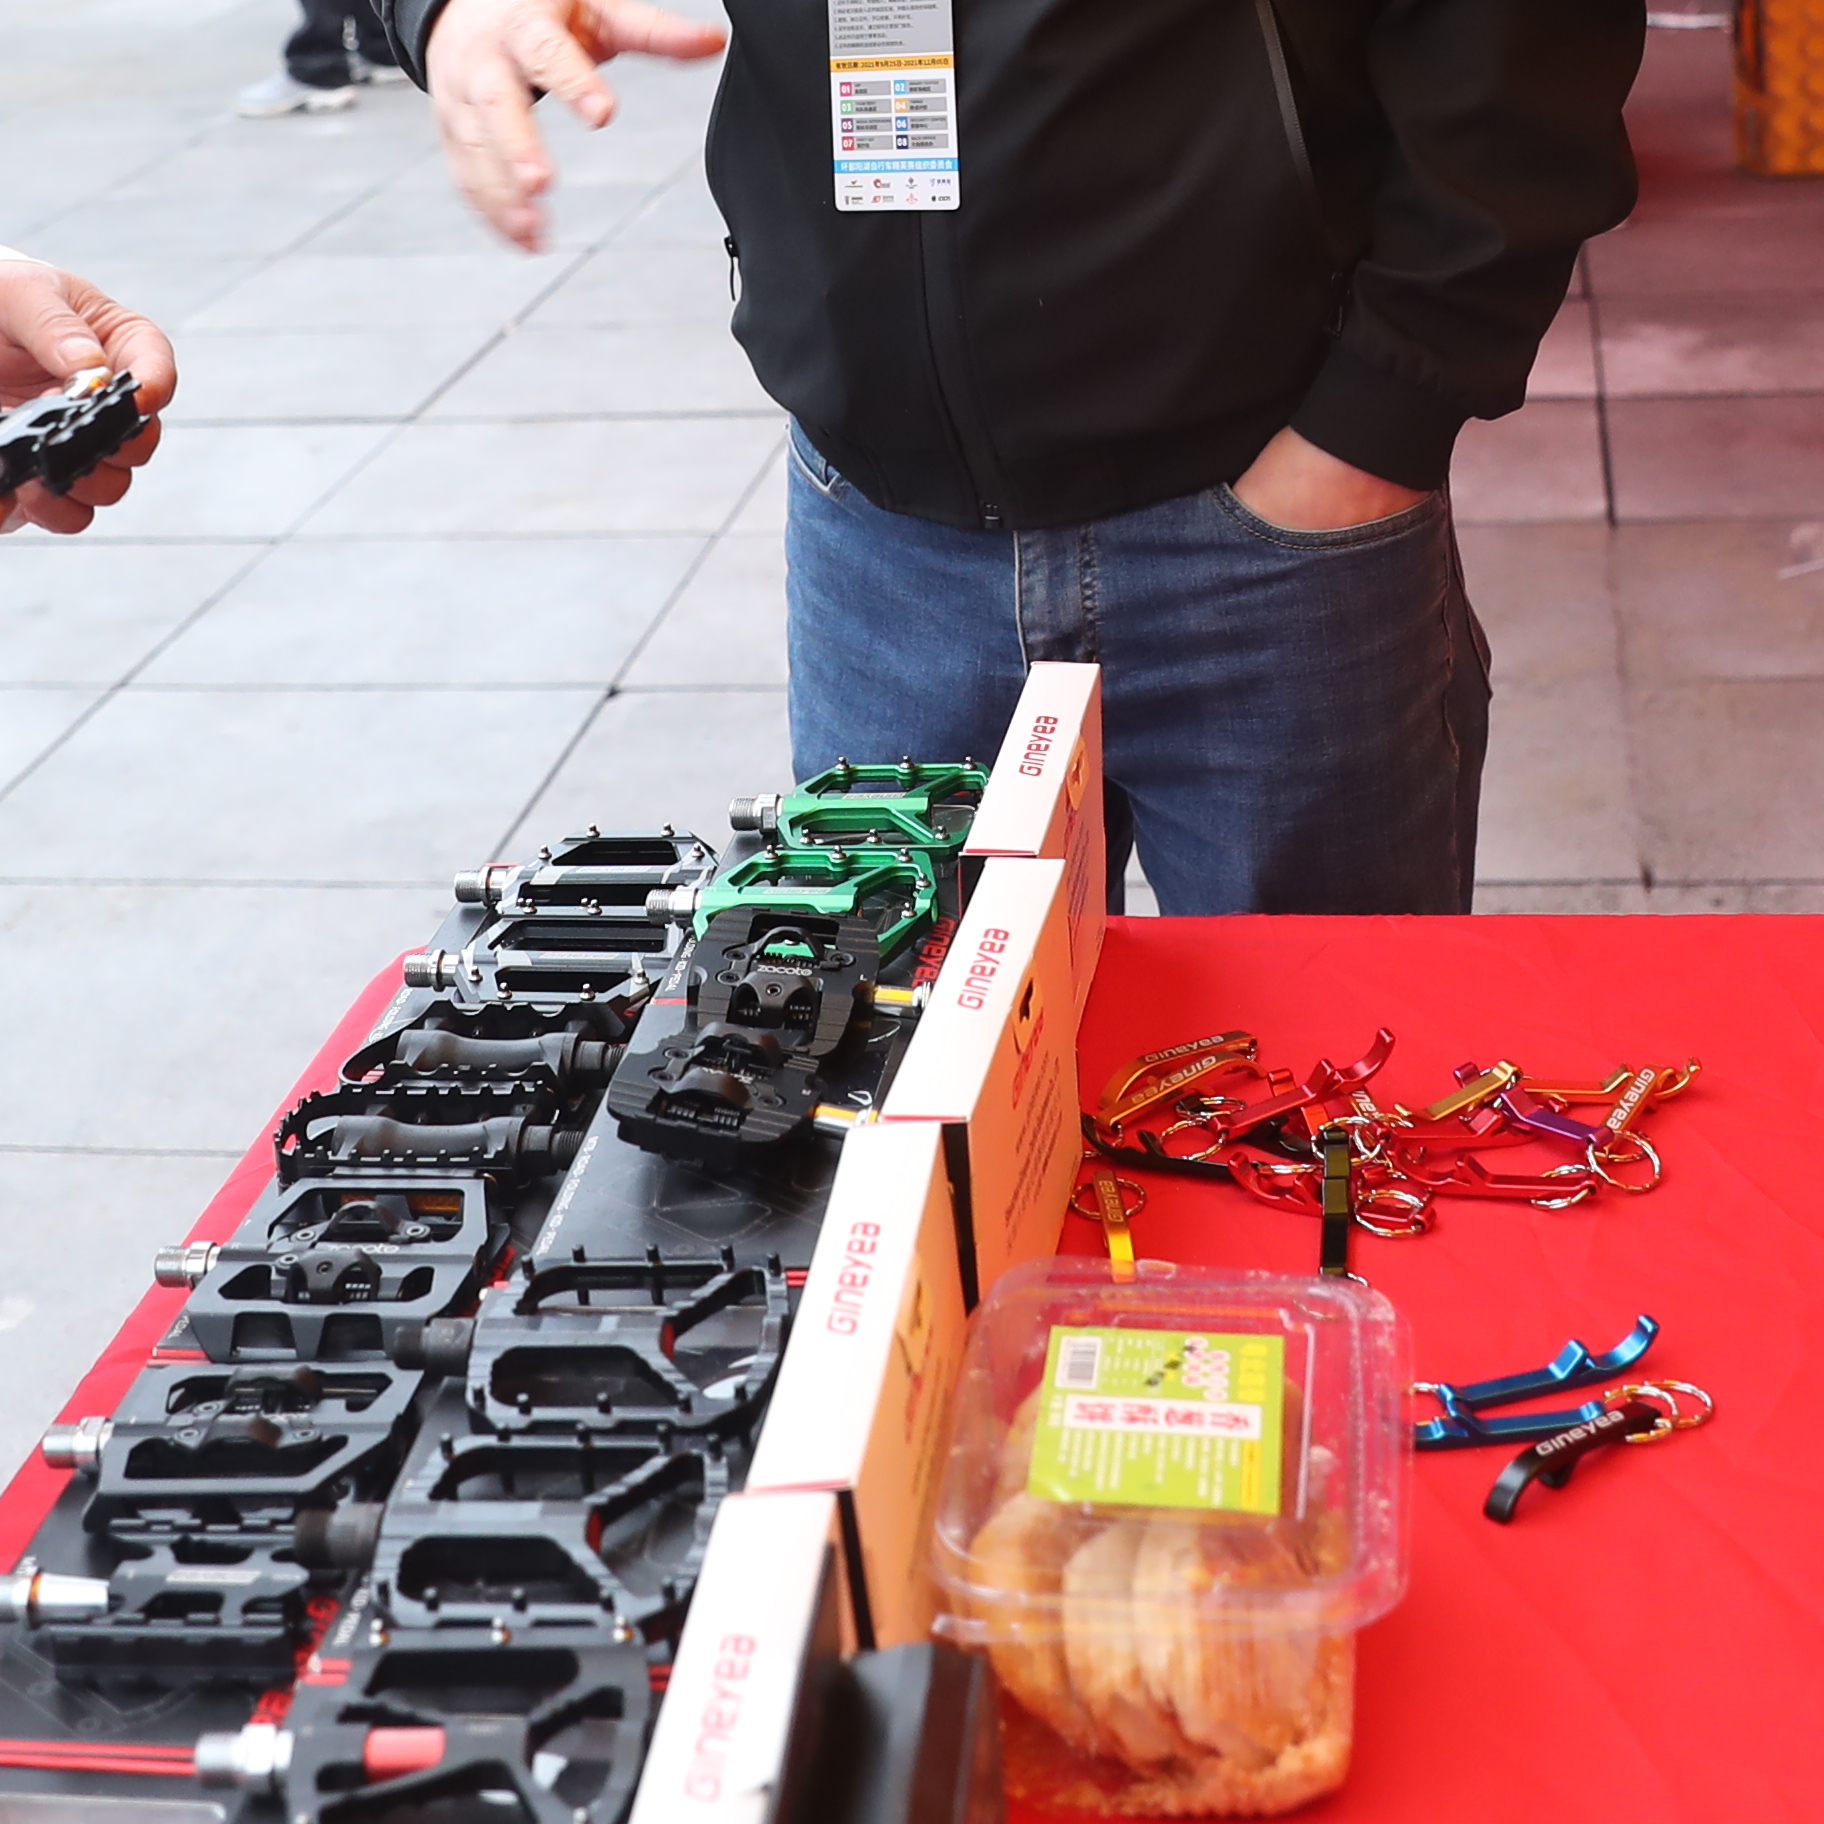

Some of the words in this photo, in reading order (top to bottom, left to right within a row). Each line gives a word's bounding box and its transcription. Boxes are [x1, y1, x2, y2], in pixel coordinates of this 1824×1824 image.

[841, 84, 851, 94] 01
[894, 83, 906, 93] 02
[842, 102, 852, 112] 03
[895, 101, 906, 111] 04
[842, 120, 852, 130] 05
[896, 119, 907, 129] 06
[842, 138, 853, 148] 07
[896, 137, 908, 147] 08
